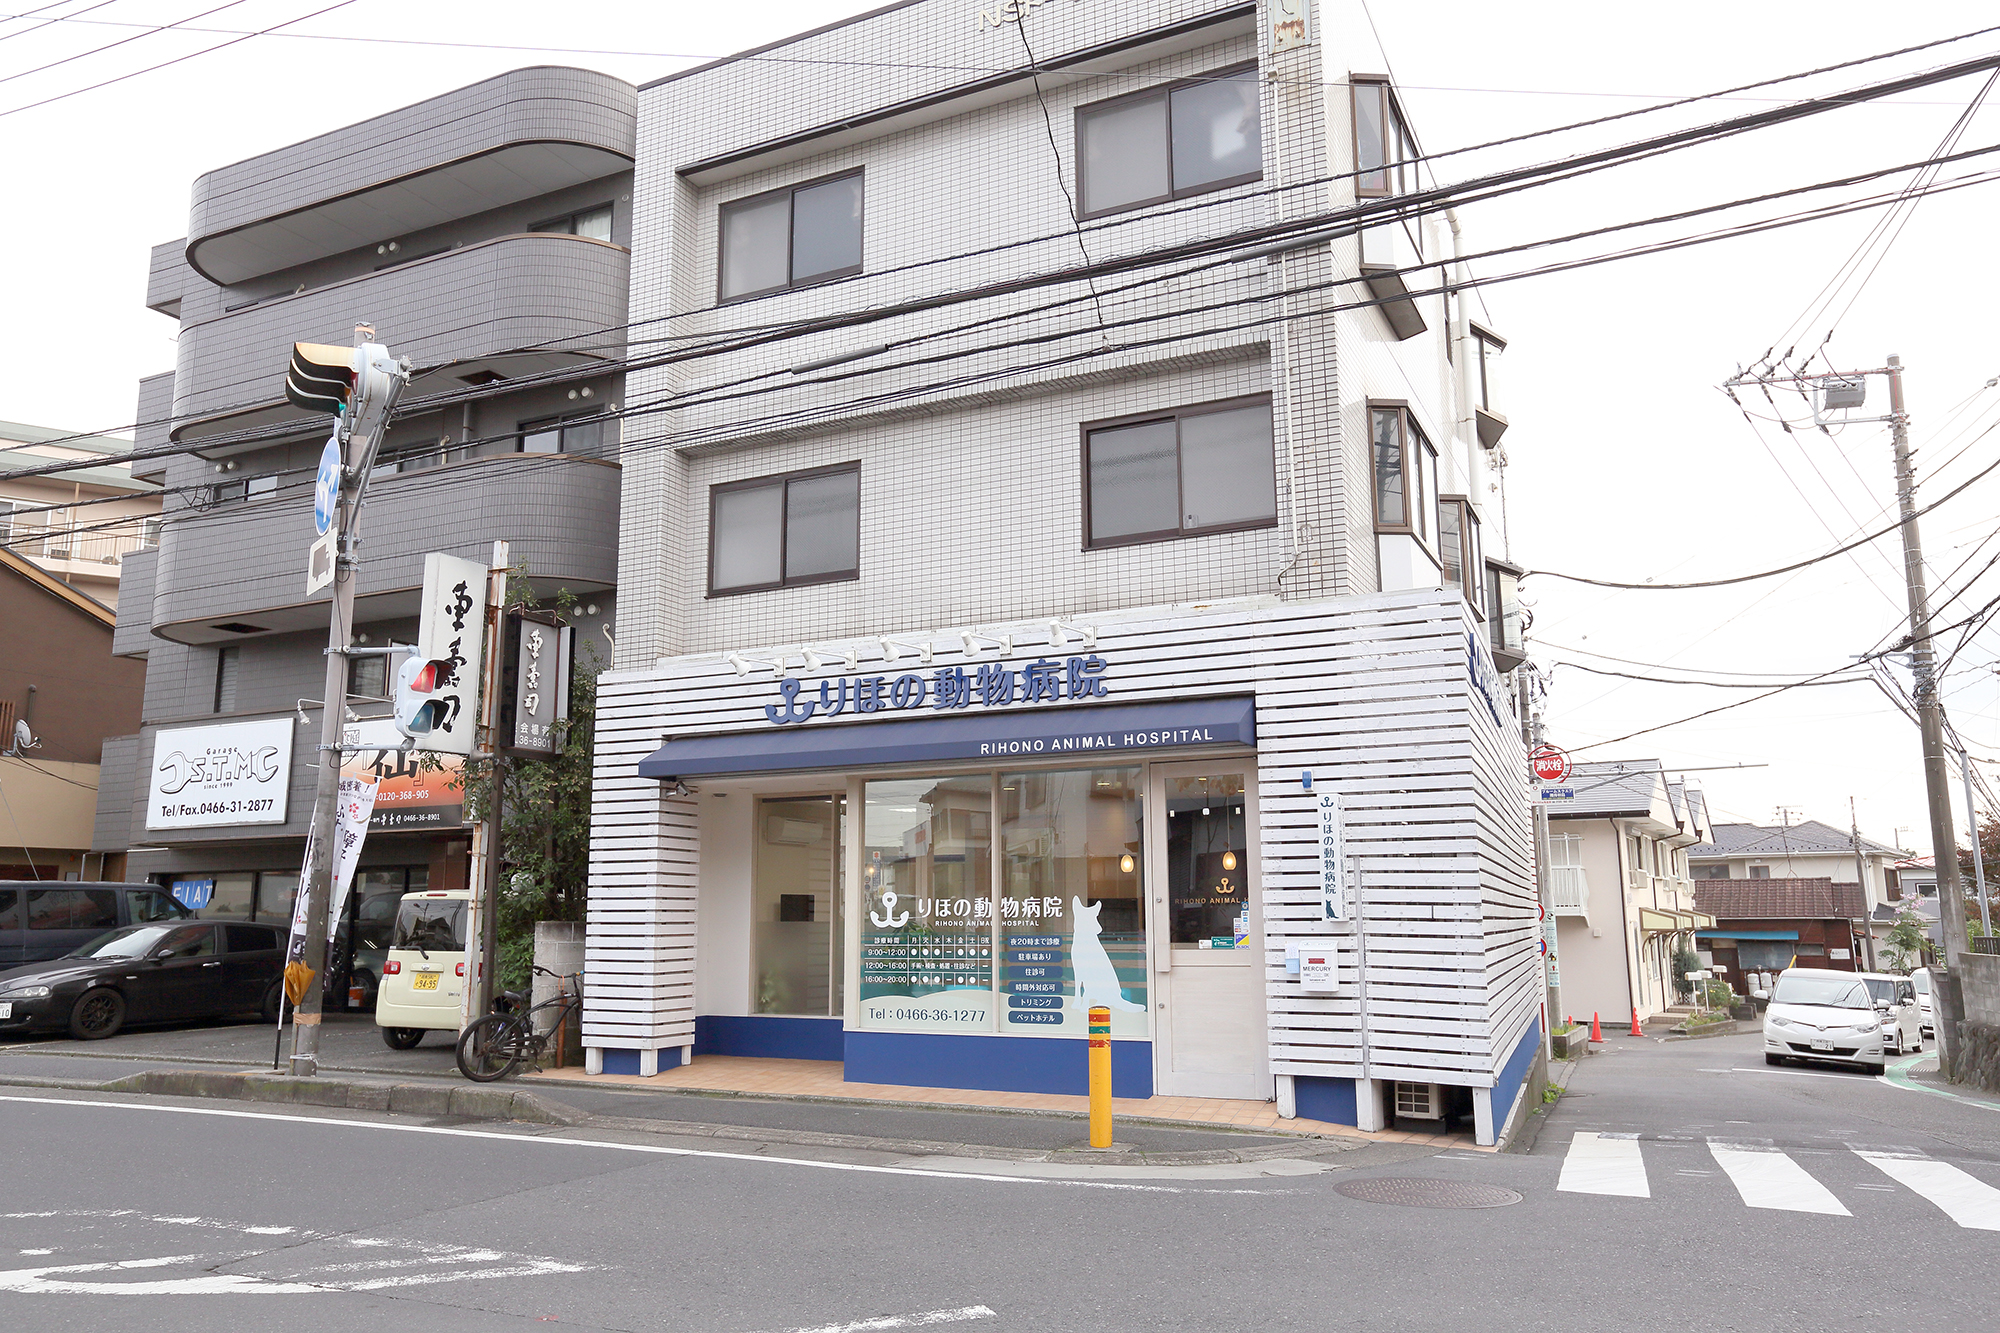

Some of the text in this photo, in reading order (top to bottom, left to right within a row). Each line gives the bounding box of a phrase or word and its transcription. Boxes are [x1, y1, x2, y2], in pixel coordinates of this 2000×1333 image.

[820, 654, 1108, 717] りほの動物病院
[980, 729, 1214, 755] RIHONO ANIMAL HOSPITAL
[206, 747, 238, 755] Garage
[1535, 758, 1563, 772] 消火栓
[162, 799, 274, 818] Tel/Fax.0466-31-2877
[1322, 811, 1337, 895] りほの動物病院
[173, 885, 213, 904] FIAT
[918, 896, 1063, 918] りほの動物病院
[874, 936, 900, 944] 診療時間
[1010, 938, 1060, 946] 夜20時まで診療
[1018, 953, 1052, 961] 駐車場あり
[1015, 983, 1056, 992] 時間外対応可
[1020, 998, 1052, 1007] トリミング
[896, 1008, 986, 1022] 0466-36-1277
[1016, 1013, 1056, 1022] ペットホテル
